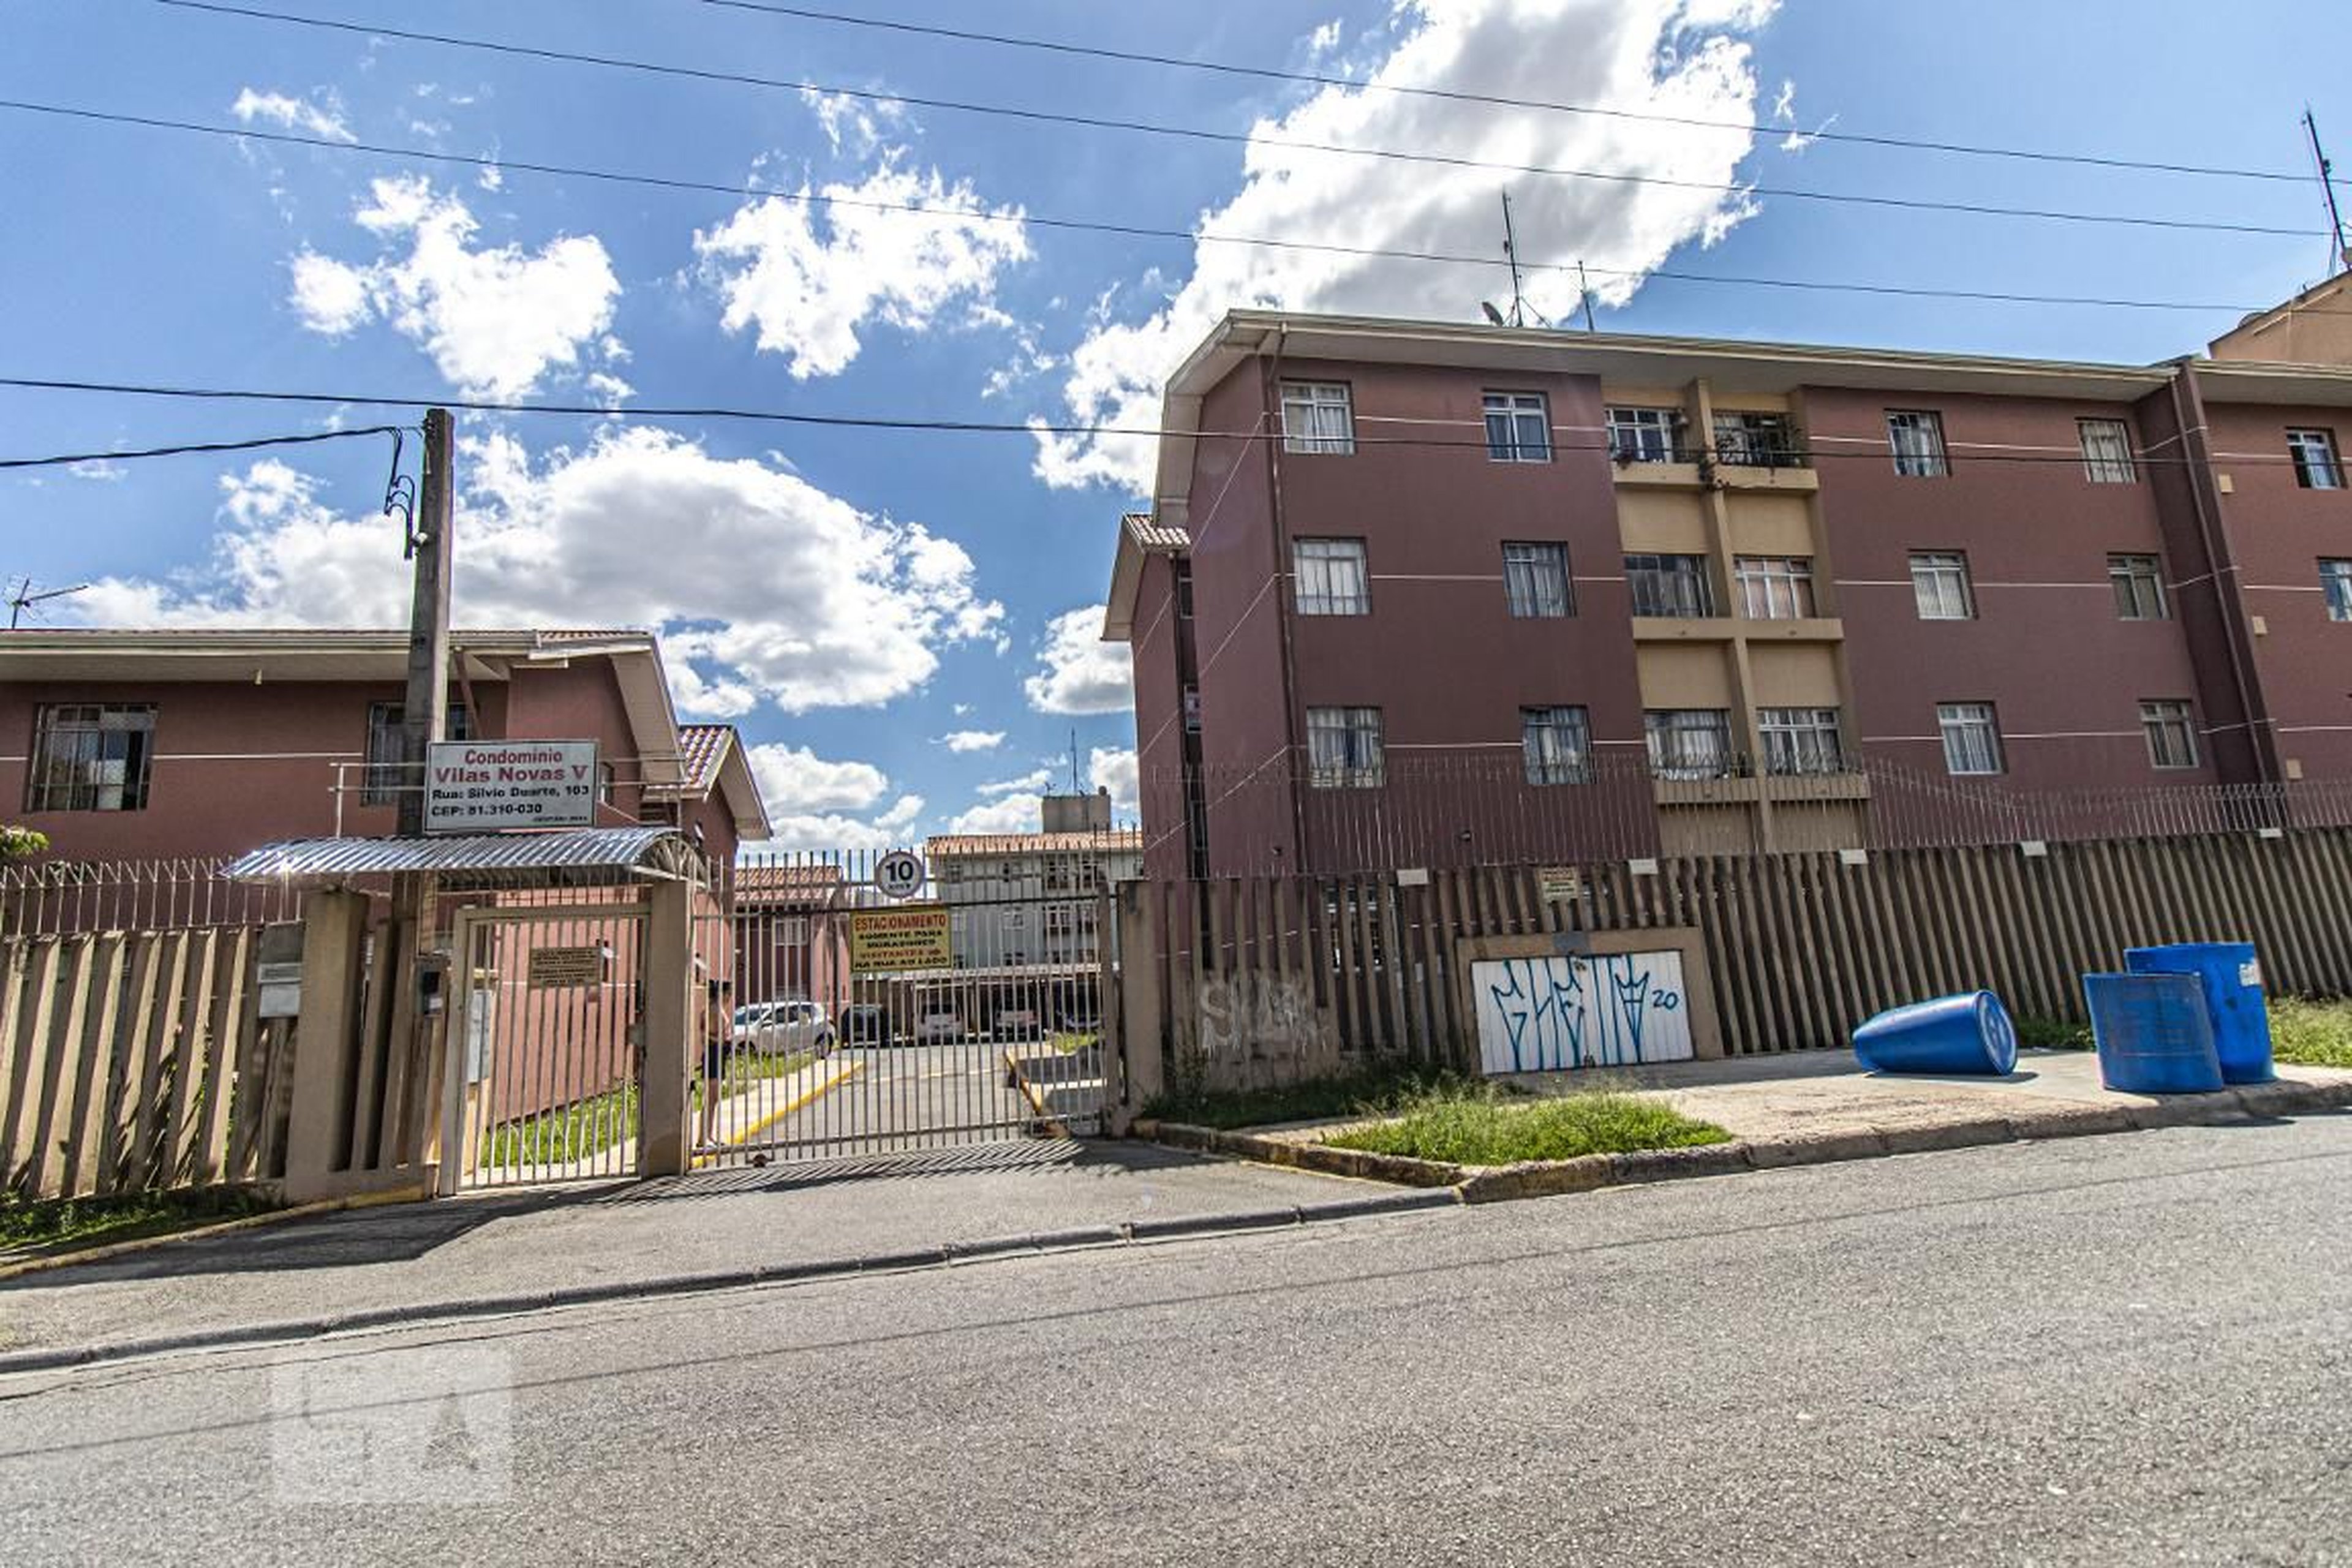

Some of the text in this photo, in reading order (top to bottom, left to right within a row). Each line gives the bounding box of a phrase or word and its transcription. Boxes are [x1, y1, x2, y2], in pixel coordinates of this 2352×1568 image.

[435, 764, 589, 783] Vilas Novas V
[432, 790, 464, 800] Rua:
[431, 805, 464, 817] CEP:
[886, 861, 913, 881] 10
[855, 914, 946, 932] ESTACIONAMENTO
[1653, 990, 1678, 1010] 20
